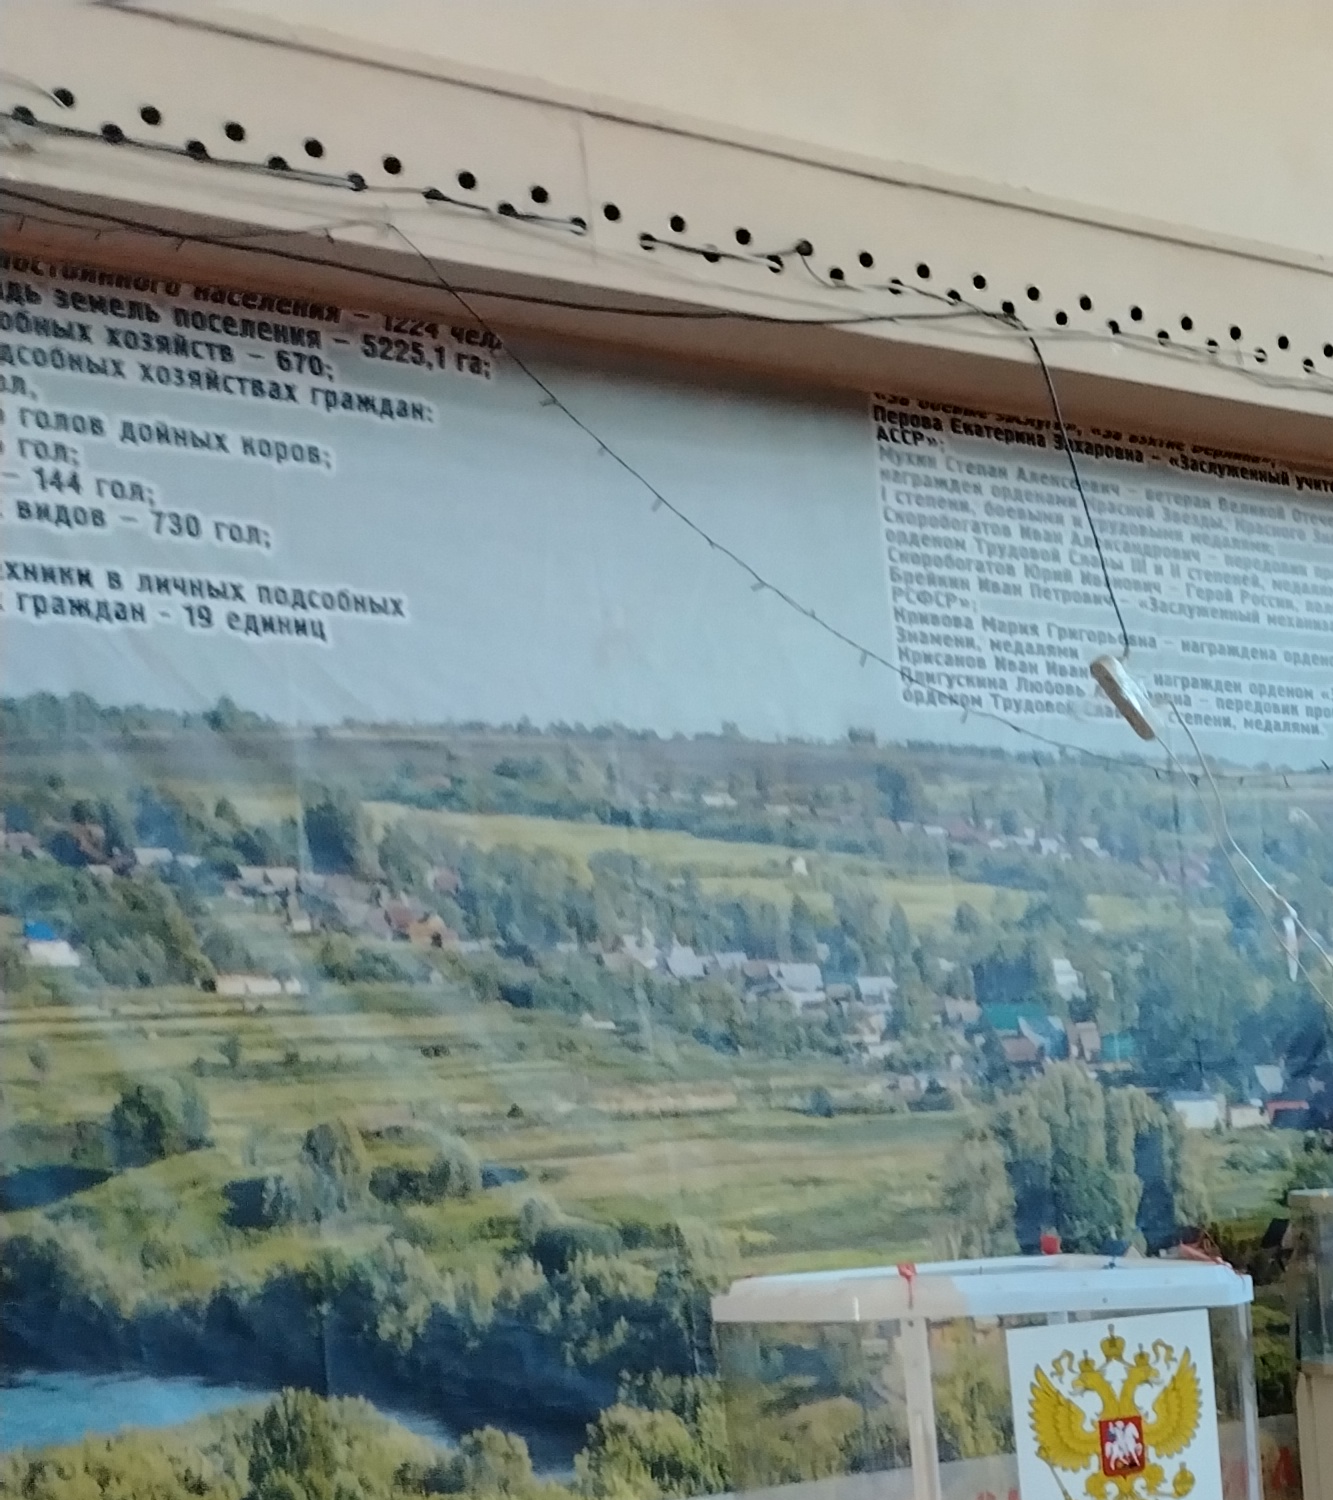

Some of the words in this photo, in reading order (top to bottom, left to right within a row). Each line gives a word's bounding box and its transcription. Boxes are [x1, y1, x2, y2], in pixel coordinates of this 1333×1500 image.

[52, 287, 160, 323] земель
[173, 305, 321, 348] поселения
[361, 333, 446, 370] 5225,1
[455, 351, 491, 379] га;
[106, 325, 234, 363] хозяйств
[276, 349, 333, 381] 670;
[139, 361, 298, 402] хозяйствах
[310, 385, 432, 422] граждан:
[17, 437, 79, 466] гол;
[18, 406, 104, 436] голов
[119, 419, 230, 453] дойных
[240, 435, 331, 469] коров;
[872, 404, 943, 432] Перова
[950, 416, 1046, 448] Екатерина
[1053, 433, 1144, 463] Захаровна
[1168, 452, 1290, 486] «Заслуженный
[32, 466, 81, 495] 144
[94, 477, 155, 507] гол;
[878, 445, 937, 469] Мухин
[944, 456, 1008, 479] Степан
[1015, 465, 1120, 496] Алексеевич
[1144, 487, 1211, 510] ветеран
[1218, 496, 1285, 520] Великой
[880, 467, 982, 495] награжден
[15, 499, 106, 529] видов
[149, 508, 202, 538] 730
[213, 520, 271, 549] гол;
[983, 500, 1064, 525] боевыми
[1071, 515, 1082, 528] и
[883, 505, 1011, 538] Скоробогатов
[1019, 524, 1063, 545] Иван
[1070, 531, 1200, 563] Александрович
[1223, 553, 1307, 577] передовик
[885, 528, 966, 552] орденом
[973, 535, 1060, 564] Трудовой
[1153, 563, 1163, 576] и
[0, 560, 93, 588] хники
[105, 570, 122, 590] в
[136, 572, 246, 602] личных
[256, 583, 405, 617] подсобных
[887, 546, 1016, 577] Скоробогатов
[1023, 562, 1073, 584] Юрий
[1080, 569, 1161, 595] Иванович
[1185, 582, 1233, 603] Герой
[977, 576, 1022, 597] Иван
[1029, 582, 1113, 606] Петрович
[1137, 595, 1259, 624] «Заслуженный
[15, 591, 146, 622] граждан
[181, 603, 213, 628] 19
[225, 610, 327, 642] единиц
[893, 606, 973, 630] Кривова
[981, 615, 1039, 637] Мария
[1046, 622, 1156, 649] Григорьевна
[1181, 639, 1277, 661] награждена
[896, 625, 982, 651] Знамени,
[989, 637, 1079, 660] медалями
[897, 646, 987, 670] Крисанов
[993, 655, 1038, 674] Иван
[1153, 673, 1242, 694] награжден
[1248, 682, 1313, 700] орденом
[902, 688, 982, 710] орденом
[1015, 676, 1085, 698] Любовь
[1215, 697, 1299, 716] передовик
